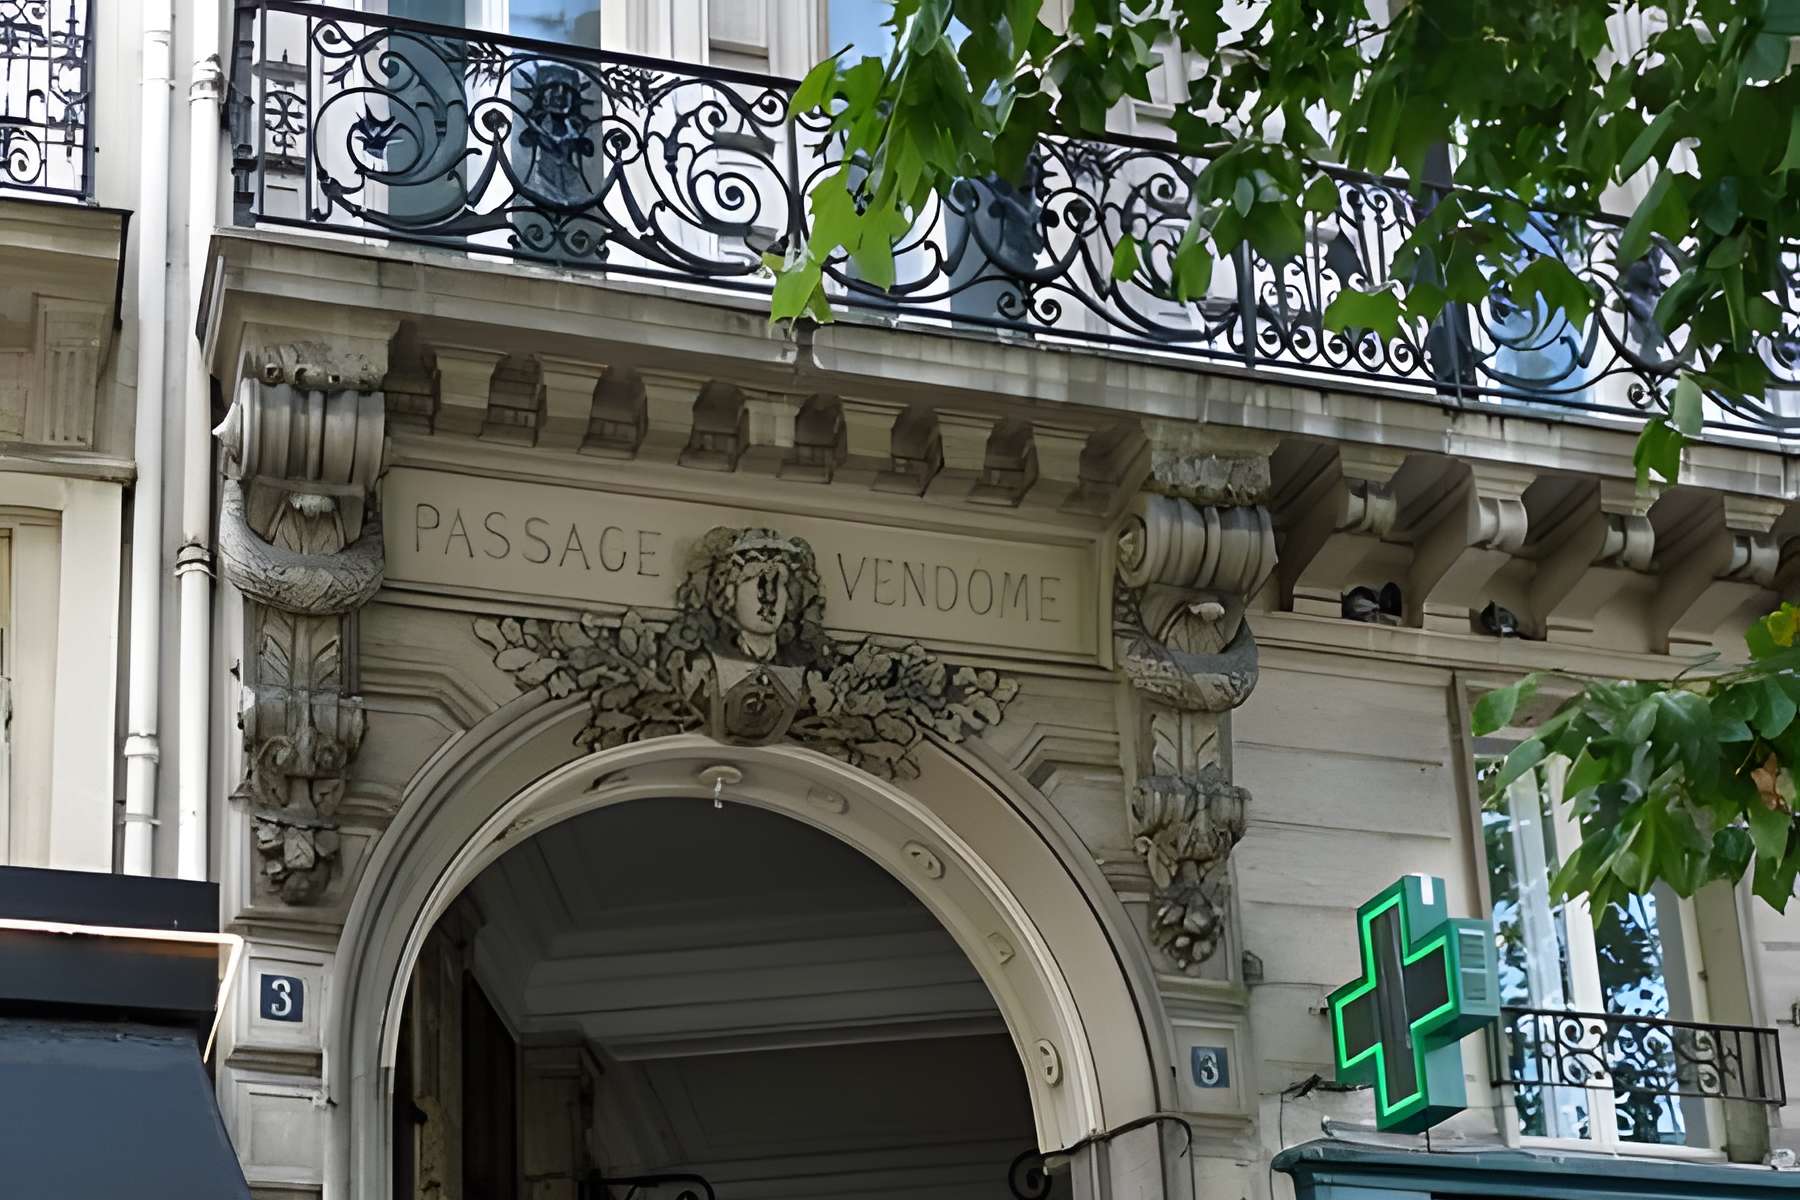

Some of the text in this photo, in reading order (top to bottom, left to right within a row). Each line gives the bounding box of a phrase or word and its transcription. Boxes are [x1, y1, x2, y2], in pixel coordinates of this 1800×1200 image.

[415, 502, 1063, 623] PASSAGE VENDOME
[271, 979, 292, 1016] 3
[1199, 1049, 1219, 1085] 3
